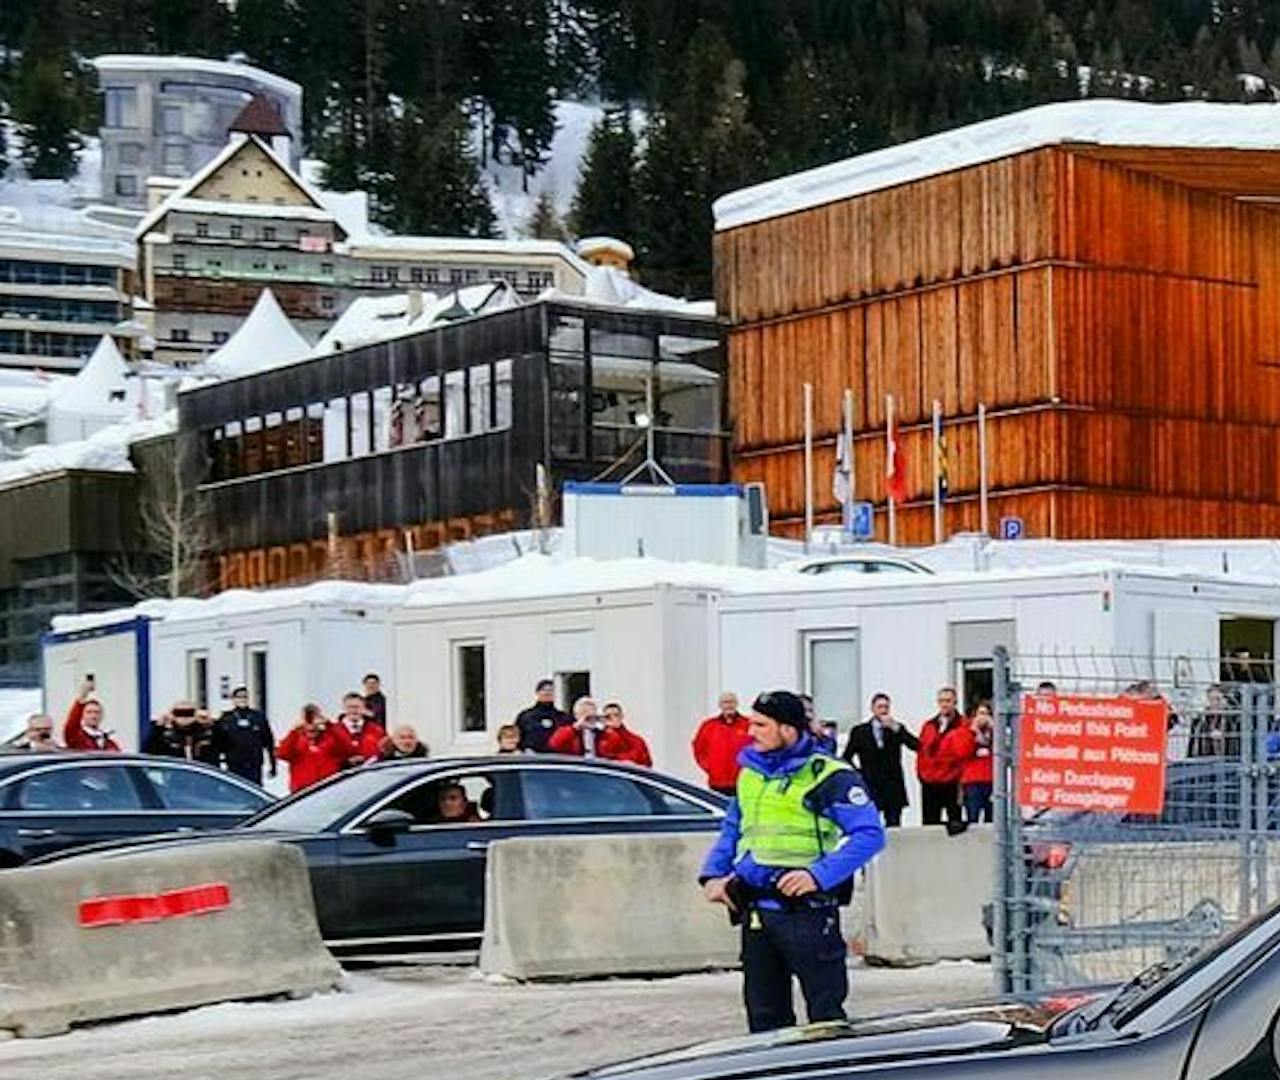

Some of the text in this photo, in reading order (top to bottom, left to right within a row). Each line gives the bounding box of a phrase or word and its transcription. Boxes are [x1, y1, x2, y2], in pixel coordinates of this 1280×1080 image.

[1007, 522, 1019, 538] P
[1035, 700, 1134, 718] No Pedestrians
[1034, 718, 1083, 737] beyond
[1085, 720, 1111, 736] this
[1031, 768, 1135, 791] Kein Durchgang
